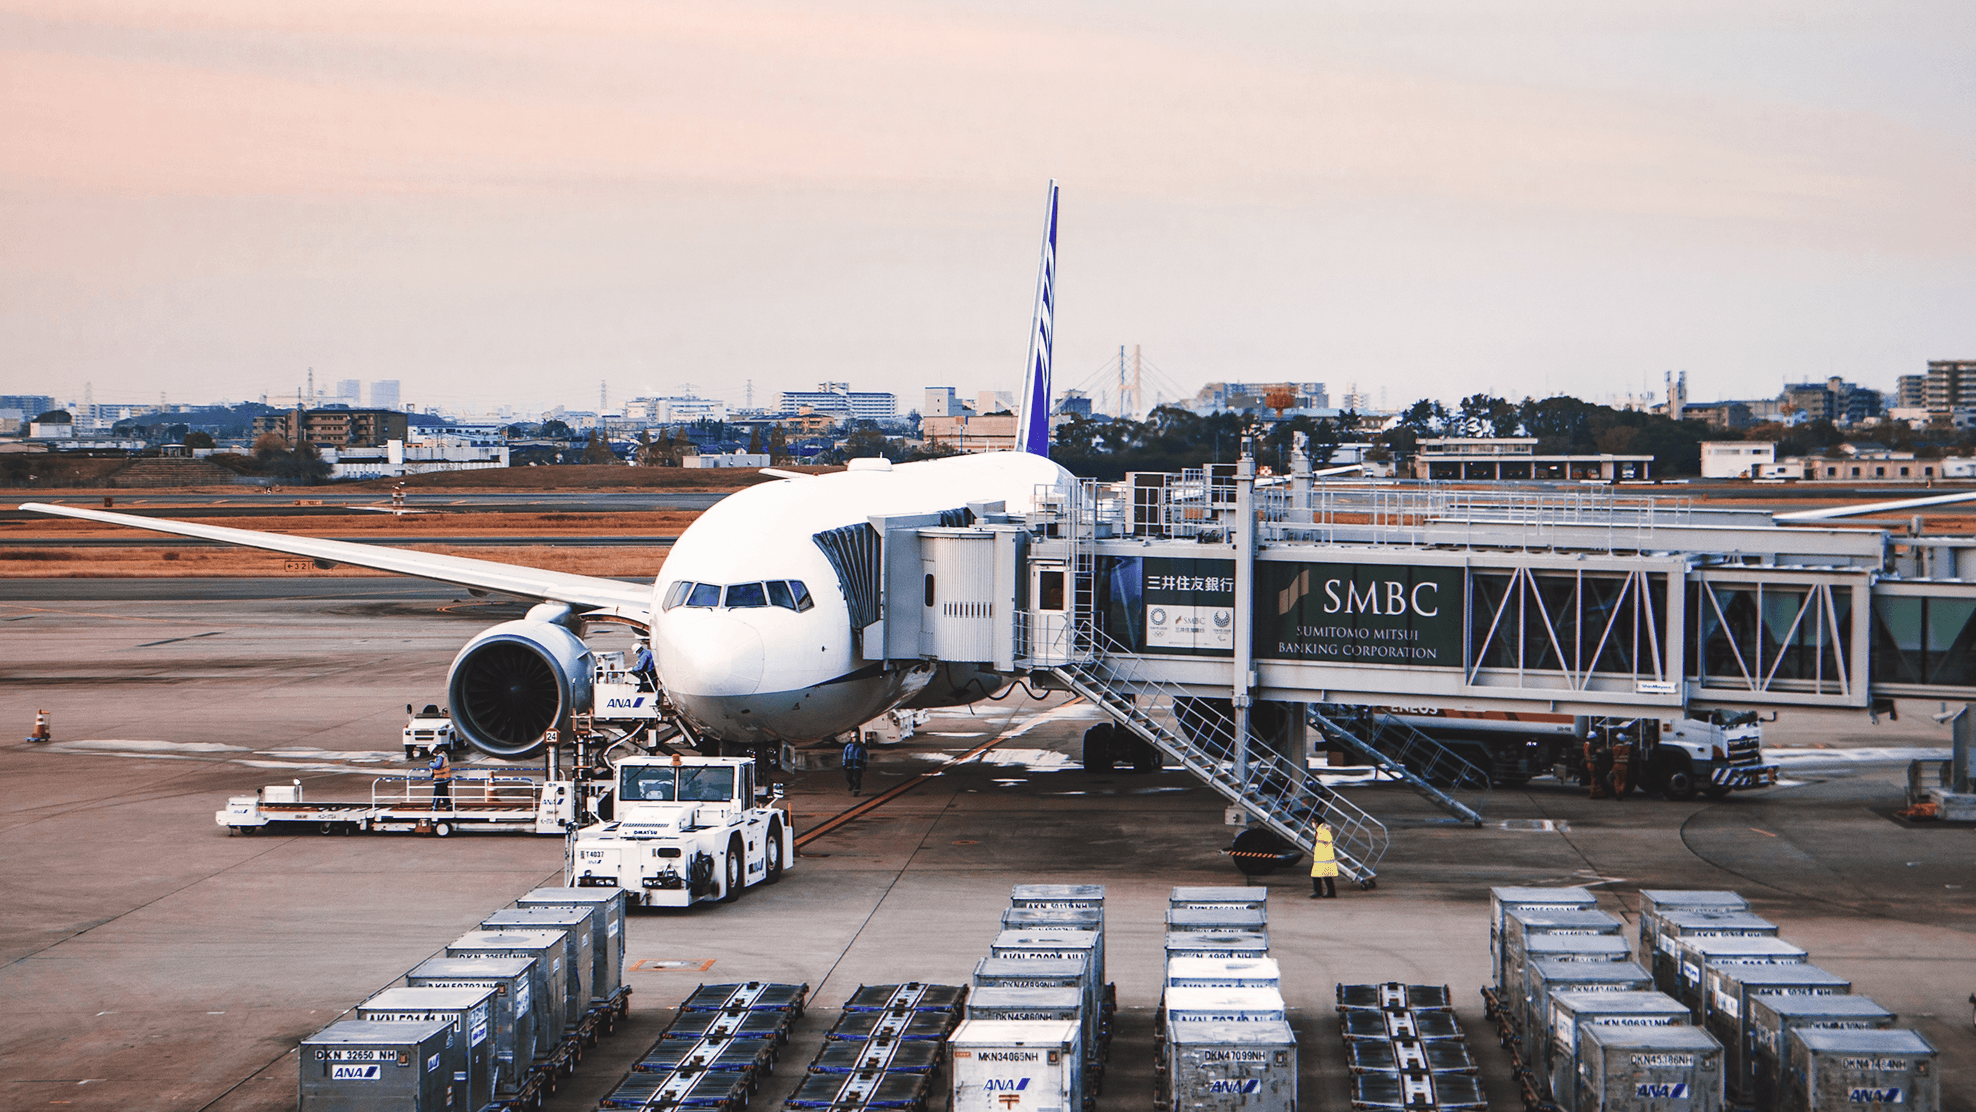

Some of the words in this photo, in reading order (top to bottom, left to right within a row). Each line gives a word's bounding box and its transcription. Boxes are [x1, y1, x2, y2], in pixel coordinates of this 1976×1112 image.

[1147, 575, 1234, 592] 三井住友銀行
[1323, 578, 1439, 617] SMBC
[1296, 625, 1369, 639] SUMITOMO
[1373, 629, 1419, 641] MITSUI
[1278, 641, 1338, 655] BANKING
[1342, 645, 1437, 659] CORPORATION
[606, 698, 632, 708] ANA
[546, 732, 556, 740] 24
[316, 1051, 342, 1060] DKN
[346, 1051, 374, 1060] 32650
[379, 1051, 395, 1060] NH
[333, 1067, 364, 1078] ANA
[983, 1079, 1015, 1091] ANA
[1210, 1080, 1242, 1093] ANA
[1637, 1084, 1669, 1098] ANA
[1849, 1089, 1882, 1102] ANA
